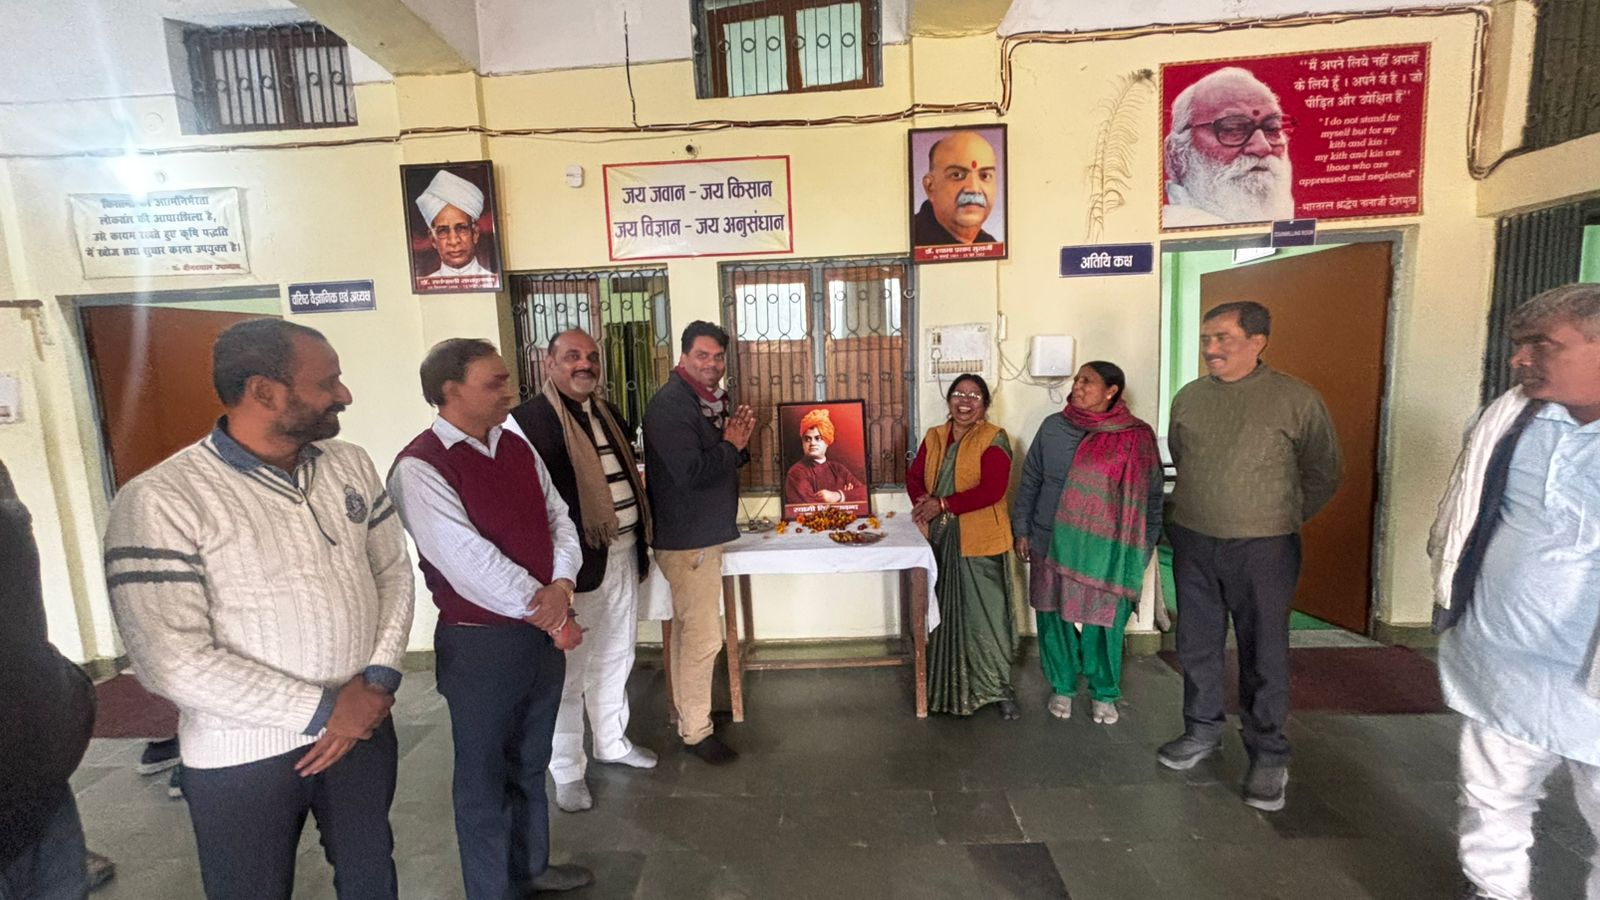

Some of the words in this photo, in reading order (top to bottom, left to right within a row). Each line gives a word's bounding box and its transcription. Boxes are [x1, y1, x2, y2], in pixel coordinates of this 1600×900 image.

[1320, 56, 1344, 70] अपने
[1348, 54, 1369, 68] लिये
[1372, 52, 1388, 67] नहीं
[1294, 78, 1306, 91] के
[1308, 76, 1329, 90] लिये
[1352, 72, 1376, 87] अपने
[1408, 70, 1422, 82] जो
[1304, 96, 1334, 110] पीड़ित
[1338, 94, 1356, 106] और
[1358, 91, 1392, 106] उपेक्षित
[1330, 118, 1342, 126] do
[1360, 115, 1386, 124] stand
[1387, 114, 1400, 122] for
[1320, 128, 1350, 138] myself
[1352, 127, 1367, 136] but
[1369, 126, 1380, 134] for
[1383, 126, 1398, 135] my
[1328, 140, 1346, 149] kith
[1348, 139, 1366, 147] and
[1368, 138, 1383, 146] kin
[1314, 154, 1328, 162] my
[1330, 152, 1347, 160] kith
[1349, 150, 1368, 159] and
[1369, 150, 1384, 158] kin
[1326, 163, 1350, 172] those
[1352, 162, 1371, 170] who
[1348, 173, 1366, 182] and
[622, 186, 646, 204] जय
[650, 184, 686, 202] जवान
[700, 182, 724, 200] जय
[727, 176, 772, 200] किसान
[614, 221, 638, 238] जय
[640, 215, 680, 238] विज्ञान
[695, 218, 719, 234] जय
[722, 210, 785, 238] अनुसंधान
[164, 229, 176, 242] हुए
[180, 227, 199, 240] कृषि
[202, 226, 228, 238] पद्धति
[86, 246, 94, 258] में
[168, 245, 192, 254] करना
[194, 244, 227, 256] उपयुक्त
[1080, 252, 1111, 269] अतिथि
[1113, 254, 1133, 268] कक्ष
[291, 290, 309, 306] वरिष्ठ
[310, 288, 338, 306] वैज्ञानिक
[338, 290, 348, 303] एवं
[350, 290, 370, 302] अध्यक्ष
